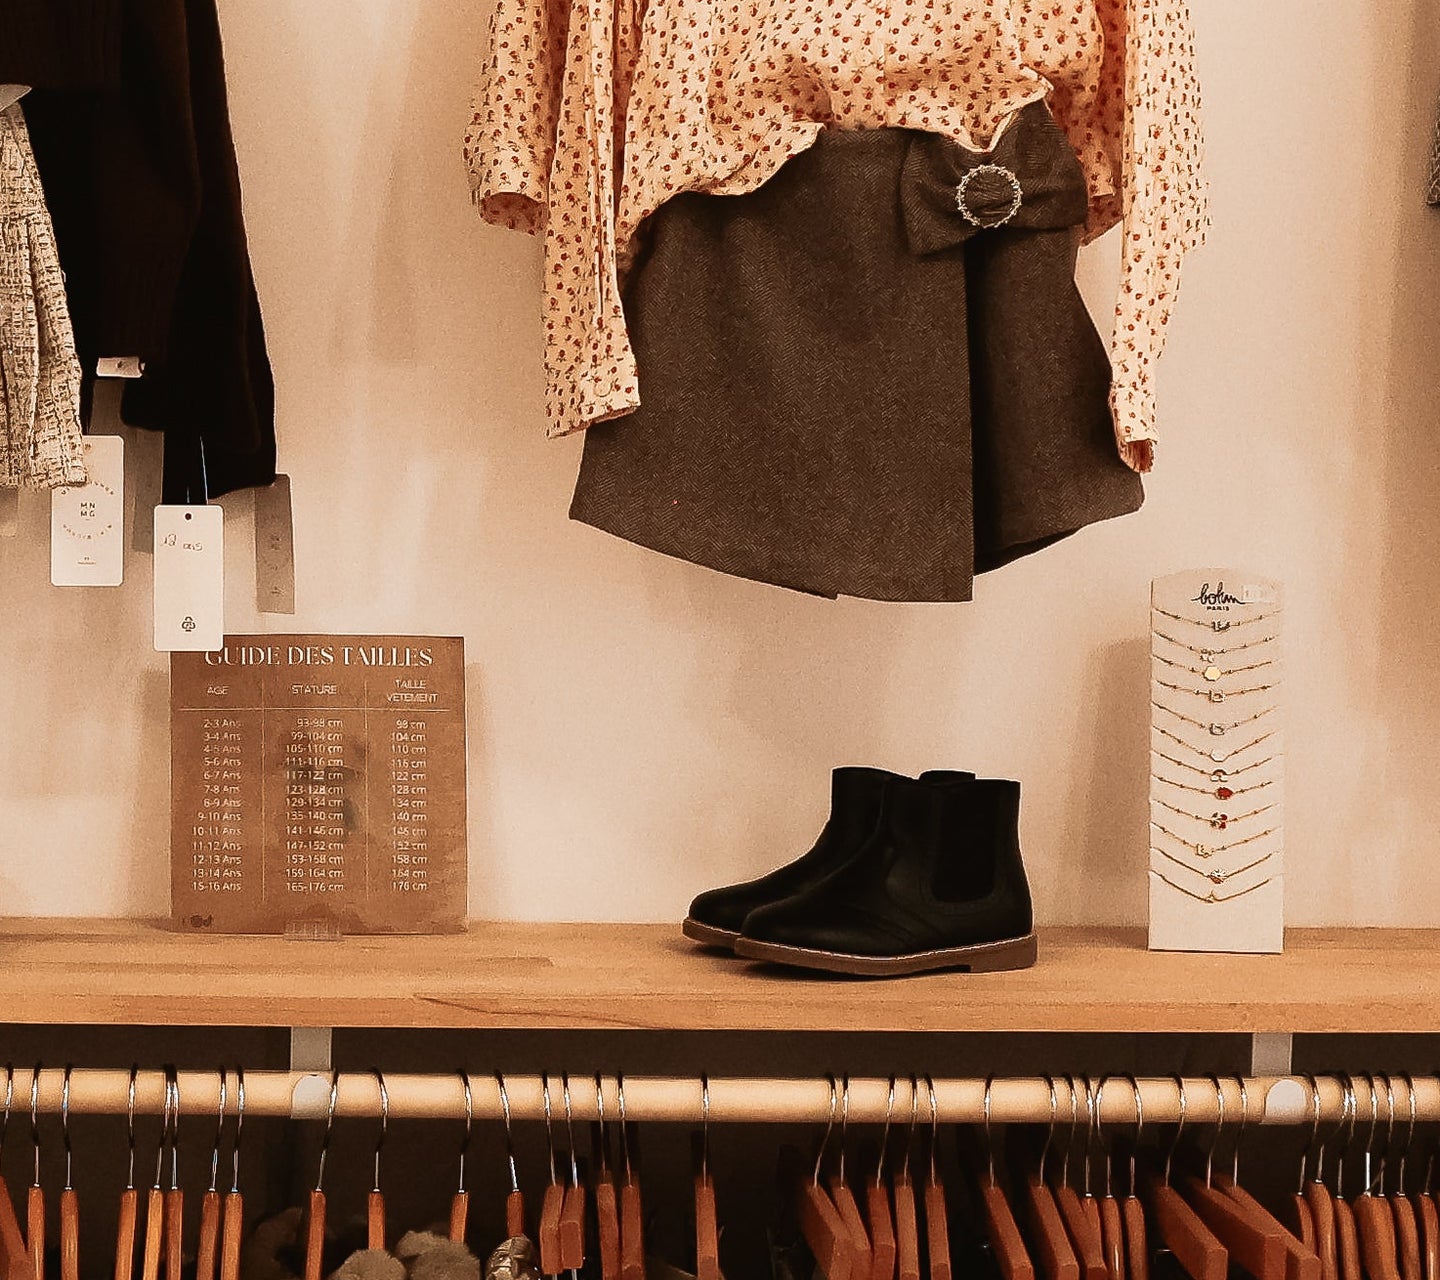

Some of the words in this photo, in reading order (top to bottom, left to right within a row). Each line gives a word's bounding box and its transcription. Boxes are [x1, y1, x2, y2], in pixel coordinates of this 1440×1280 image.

[204, 646, 280, 666] GUIDE
[288, 646, 334, 666] DES
[342, 646, 433, 667] TAILLES
[395, 679, 427, 690] TAILLE
[207, 685, 230, 695] AGE
[291, 684, 337, 696] STATURE
[222, 719, 242, 728] Ans
[328, 720, 344, 728] cm
[222, 732, 242, 741] Ans
[328, 733, 344, 741] cm
[222, 745, 242, 754] Ans
[328, 746, 344, 754] cm
[222, 758, 242, 767] Ans
[222, 771, 242, 780] Ans
[328, 772, 344, 780] cm
[222, 785, 242, 794] Ans
[328, 786, 344, 795] cm
[222, 798, 242, 807] Ans
[412, 800, 426, 808] cm
[222, 812, 242, 821] Ans
[328, 813, 344, 821] cm
[222, 826, 242, 836] Ans
[328, 828, 344, 836] cm
[412, 828, 426, 836] cm
[222, 842, 242, 850] Ans
[328, 843, 344, 851] cm
[222, 856, 242, 864] Ans
[328, 856, 344, 864] cm
[222, 869, 242, 878] Ans
[328, 870, 344, 878] cm
[222, 882, 242, 891] Ans
[328, 884, 344, 892] cm
